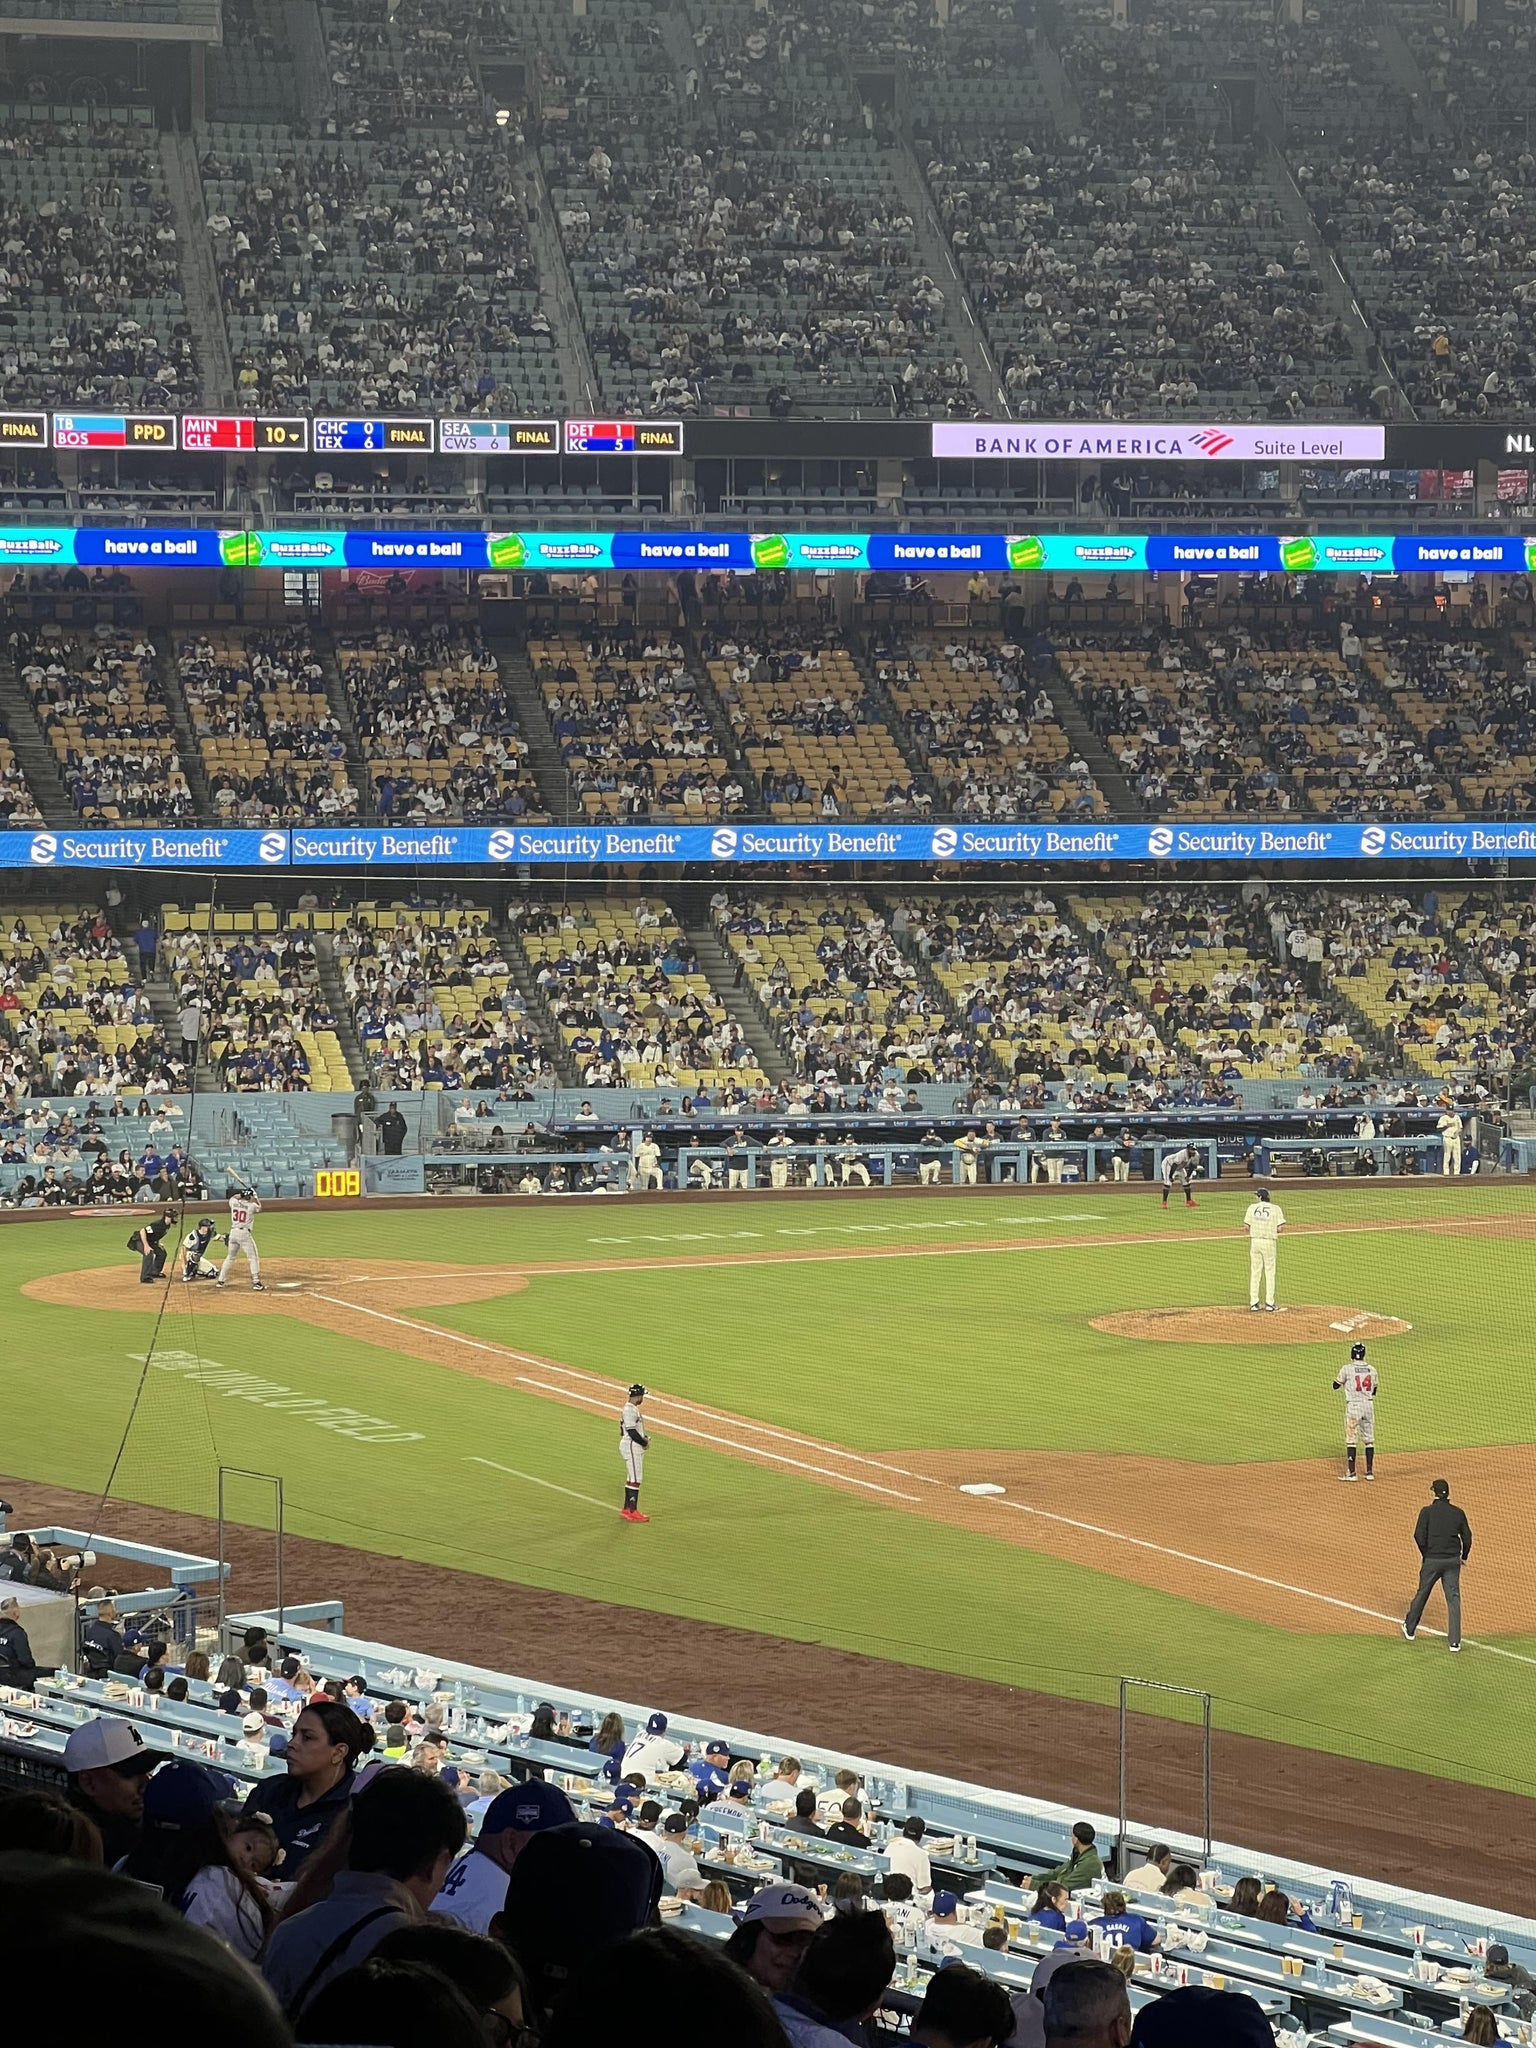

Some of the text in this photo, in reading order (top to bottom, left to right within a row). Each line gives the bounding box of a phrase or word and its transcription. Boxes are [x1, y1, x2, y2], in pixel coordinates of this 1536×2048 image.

[2, 423, 38, 437] FINAL
[57, 417, 74, 430] TB
[186, 419, 242, 433] MIN 1
[317, 421, 374, 435] CHC 0
[444, 422, 498, 436] SEA 1
[569, 423, 622, 437] DET 1
[57, 432, 89, 446] BOS
[133, 424, 166, 440] PPD
[265, 426, 286, 443] 10
[390, 429, 426, 443] FINAL
[516, 430, 551, 444] FINAL
[640, 431, 675, 445] FINAL
[186, 434, 242, 448] CLE 1
[317, 436, 374, 449] TEX 6
[444, 437, 499, 450] CWS 6
[569, 438, 624, 451] KC 5
[975, 437, 1183, 455] BANK OF AMERICA
[1254, 440, 1343, 455] Suite Level
[1506, 434, 1535, 453] NL
[104, 539, 197, 554] have a ball
[372, 541, 462, 556] have a ball
[641, 543, 730, 557] have a ball
[894, 544, 982, 559] have a ball
[1173, 545, 1259, 560] have a ball
[1418, 546, 1503, 561] have a ball
[63, 838, 146, 862] Security
[294, 836, 378, 861] Security
[519, 835, 601, 859] Security
[742, 833, 823, 858] Security
[962, 832, 1042, 857] Security
[1178, 831, 1257, 856] Security
[1390, 830, 1468, 855] Security
[232, 1209, 247, 1223] 30
[1253, 1206, 1271, 1217] 65
[1354, 1374, 1372, 1392] 14
[184, 1369, 426, 1443] UNIQLO FIELD
[626, 1741, 646, 1759] 17
[1106, 1923, 1130, 1933] SASAKI
